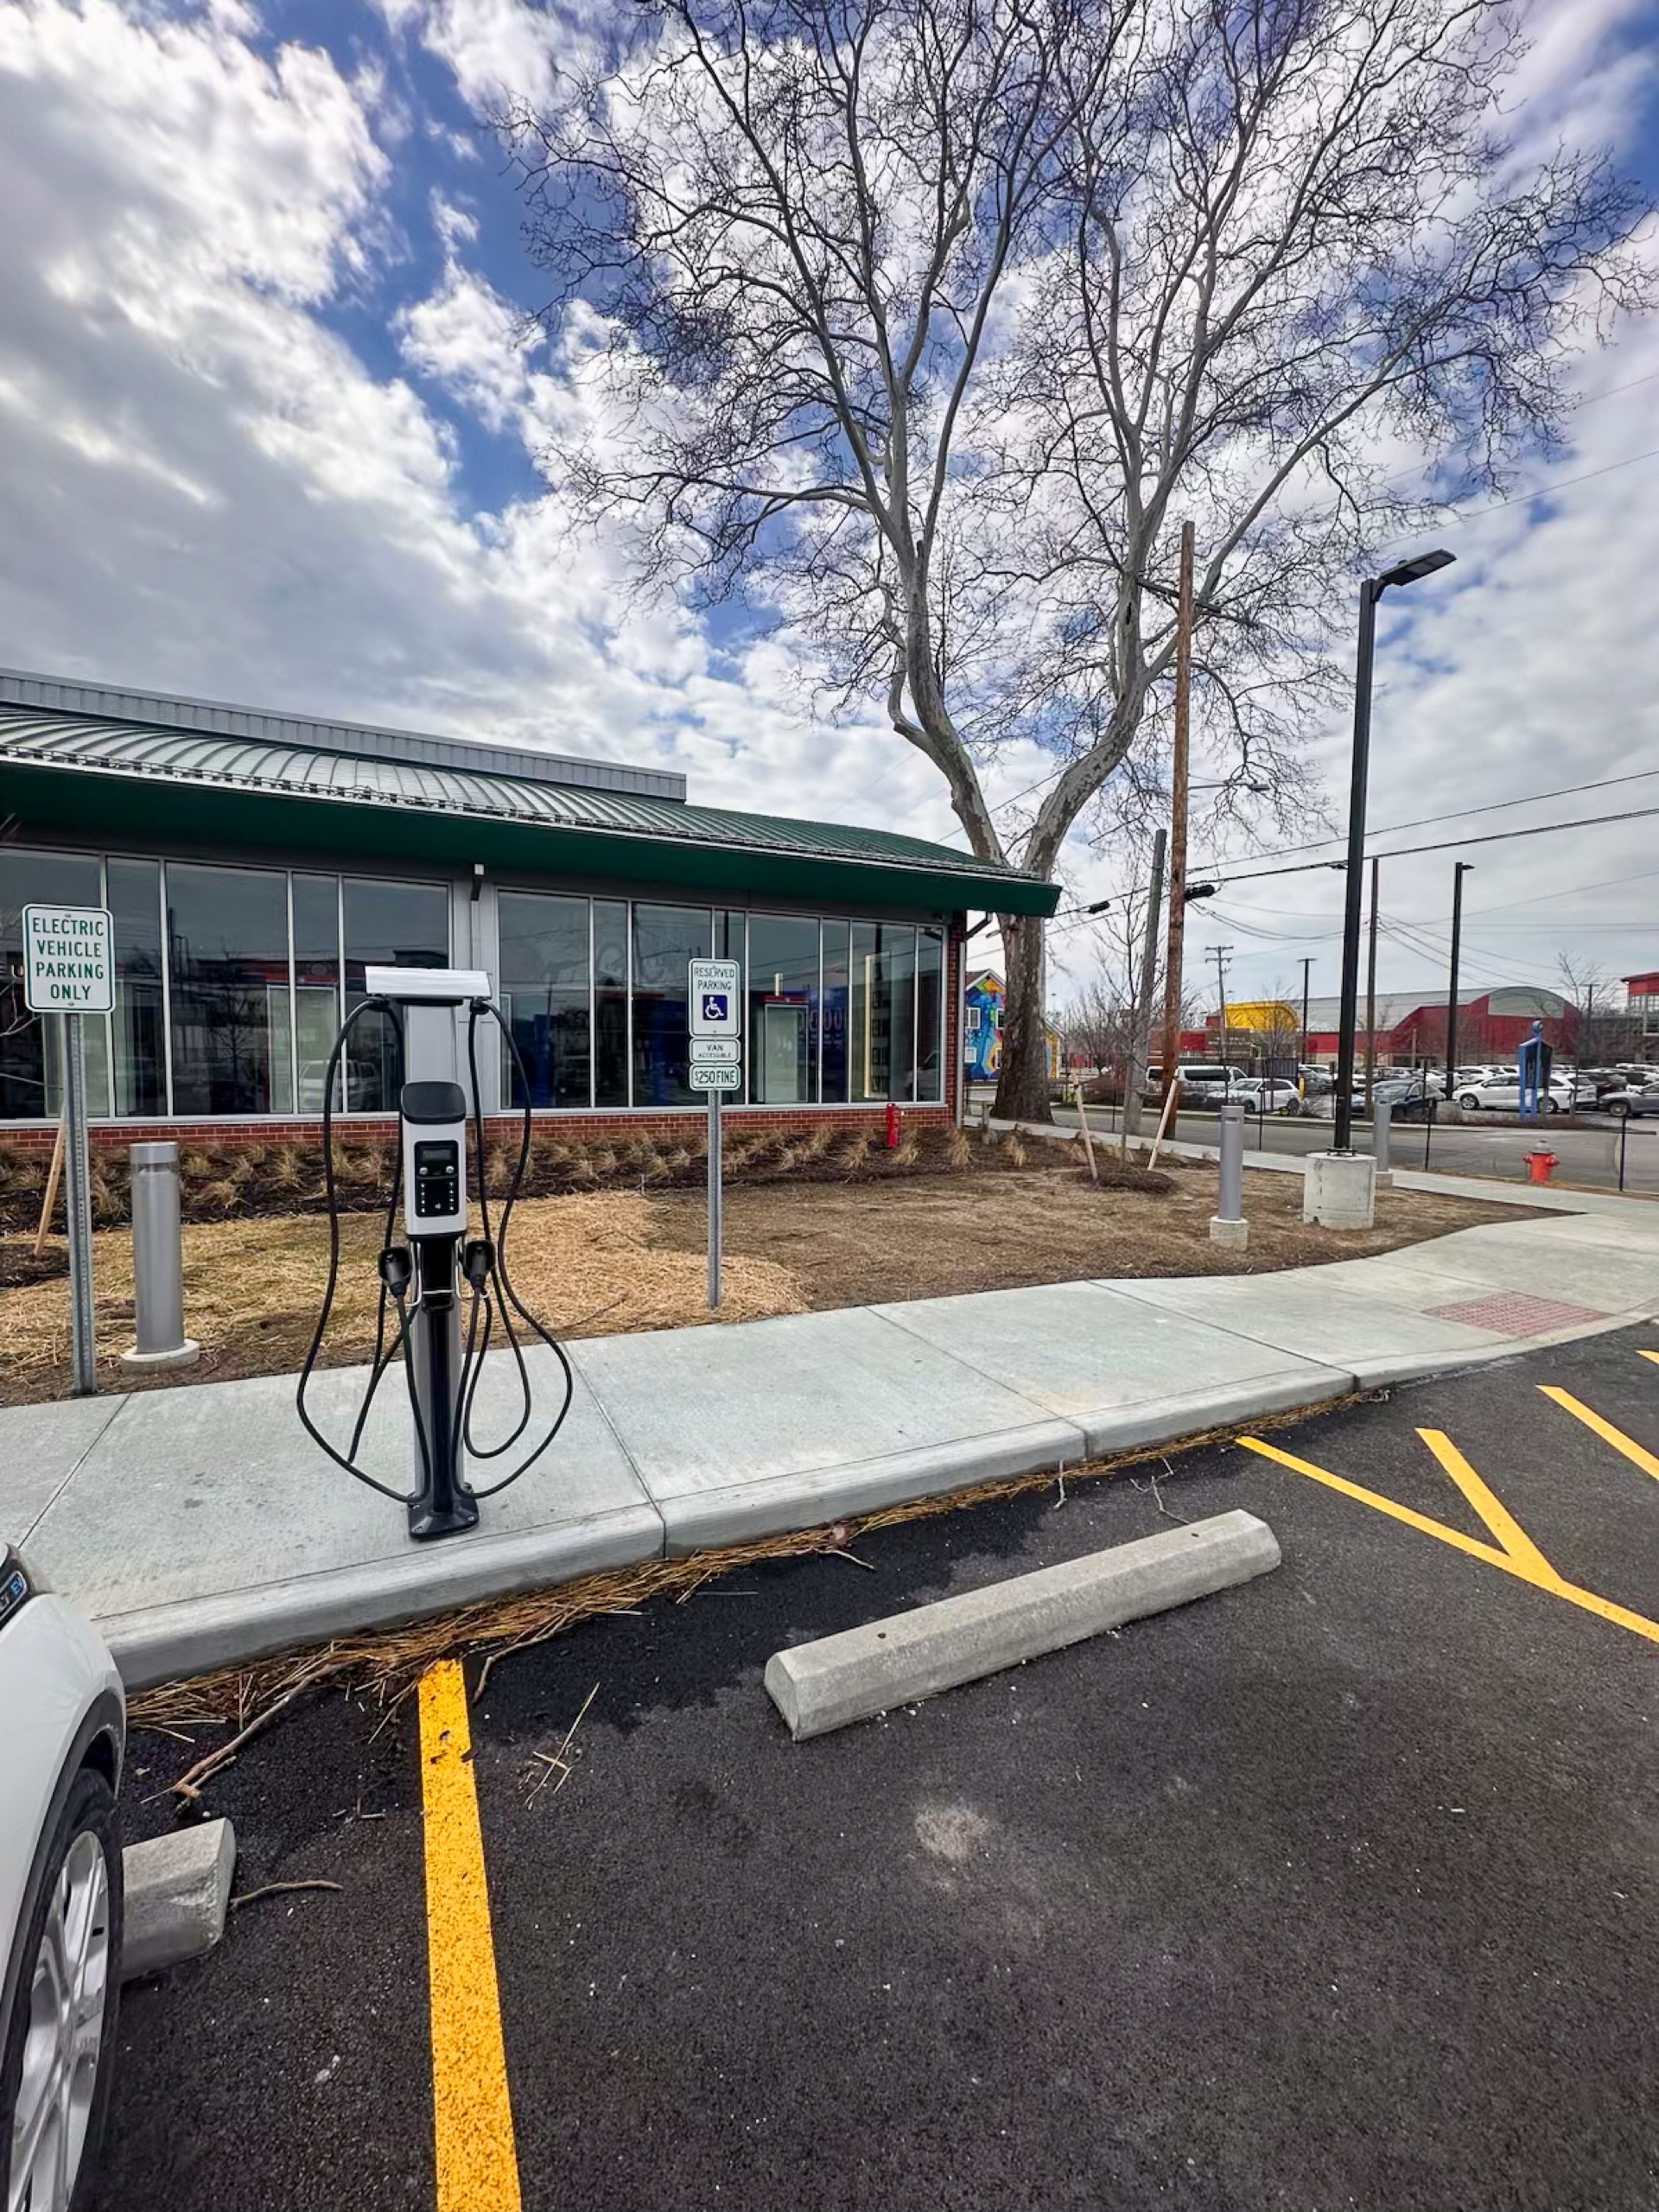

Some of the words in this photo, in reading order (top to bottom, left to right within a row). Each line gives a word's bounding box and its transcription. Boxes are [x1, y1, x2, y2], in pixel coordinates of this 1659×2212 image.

[33, 918, 104, 936] ELECTRIC
[37, 940, 101, 957] VEHICLE
[36, 962, 104, 979] PARKING
[694, 967, 735, 978] RESERVED
[50, 984, 91, 1000] ONLY
[698, 980, 732, 991] PARKING
[695, 1071, 715, 1084] $250
[716, 1071, 735, 1084] FINE
